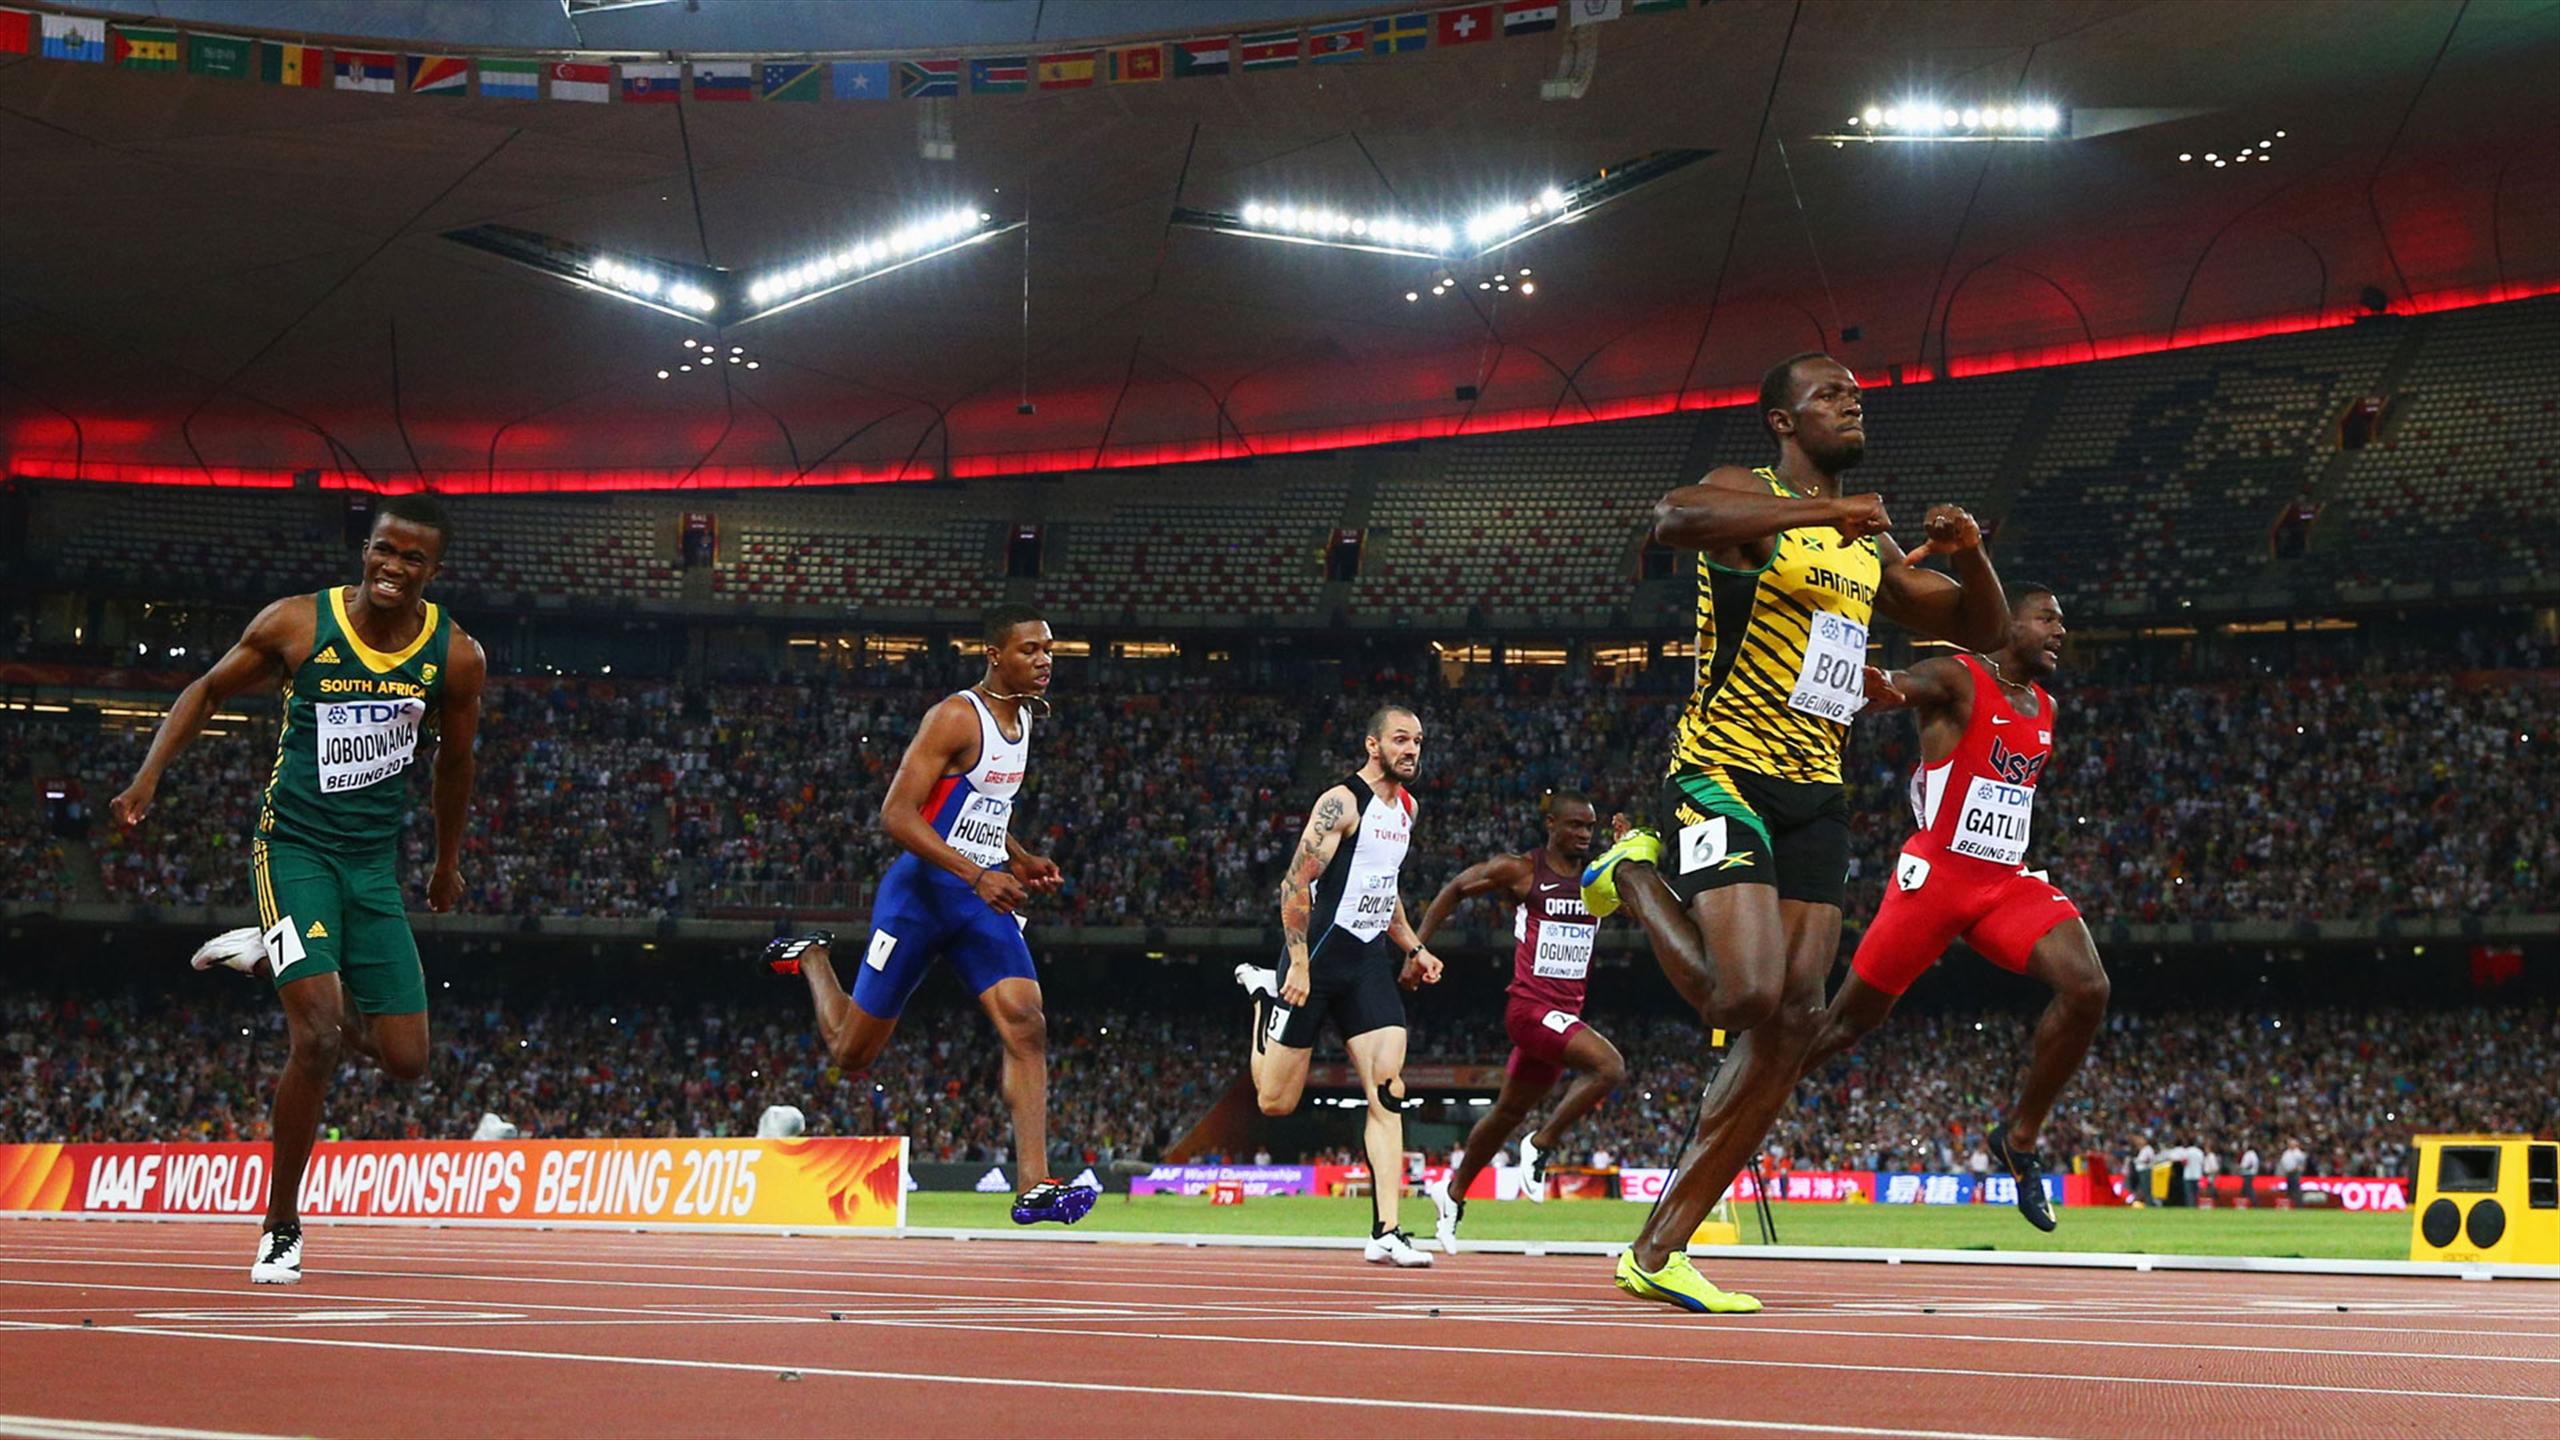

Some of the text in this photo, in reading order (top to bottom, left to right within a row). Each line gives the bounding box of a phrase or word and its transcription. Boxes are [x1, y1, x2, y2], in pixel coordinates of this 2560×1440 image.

[1805, 567, 1876, 606] JAMAIC
[1841, 622, 1865, 650] TD
[320, 679, 426, 698] SOUTH AFRICA
[347, 702, 414, 724] TDK
[1794, 692, 1845, 718] BEIJING
[321, 722, 414, 766] JOBODWANA
[1989, 736, 2049, 785] USA
[326, 768, 384, 789] BEIJING
[985, 797, 1009, 818] TDK
[1995, 785, 2031, 808] TDK
[954, 817, 1006, 849] HUGHES
[1966, 808, 2028, 842] GATLIN
[1693, 830, 1714, 864] 6
[1957, 839, 2005, 860] BEIJING
[1902, 864, 1917, 888] 4
[1546, 897, 1590, 917] QATA
[1559, 924, 1593, 940] TDK
[270, 929, 284, 967] 7
[1540, 942, 1591, 963] OGUNODE
[1537, 965, 1571, 977] BEIJING
[1270, 1010, 1280, 1031] 3
[1552, 1014, 1571, 1025] 2
[85, 1155, 163, 1210] IAAF
[163, 1154, 263, 1213] WORLD
[533, 1149, 673, 1215] BEIJING
[673, 1148, 762, 1217] 2015
